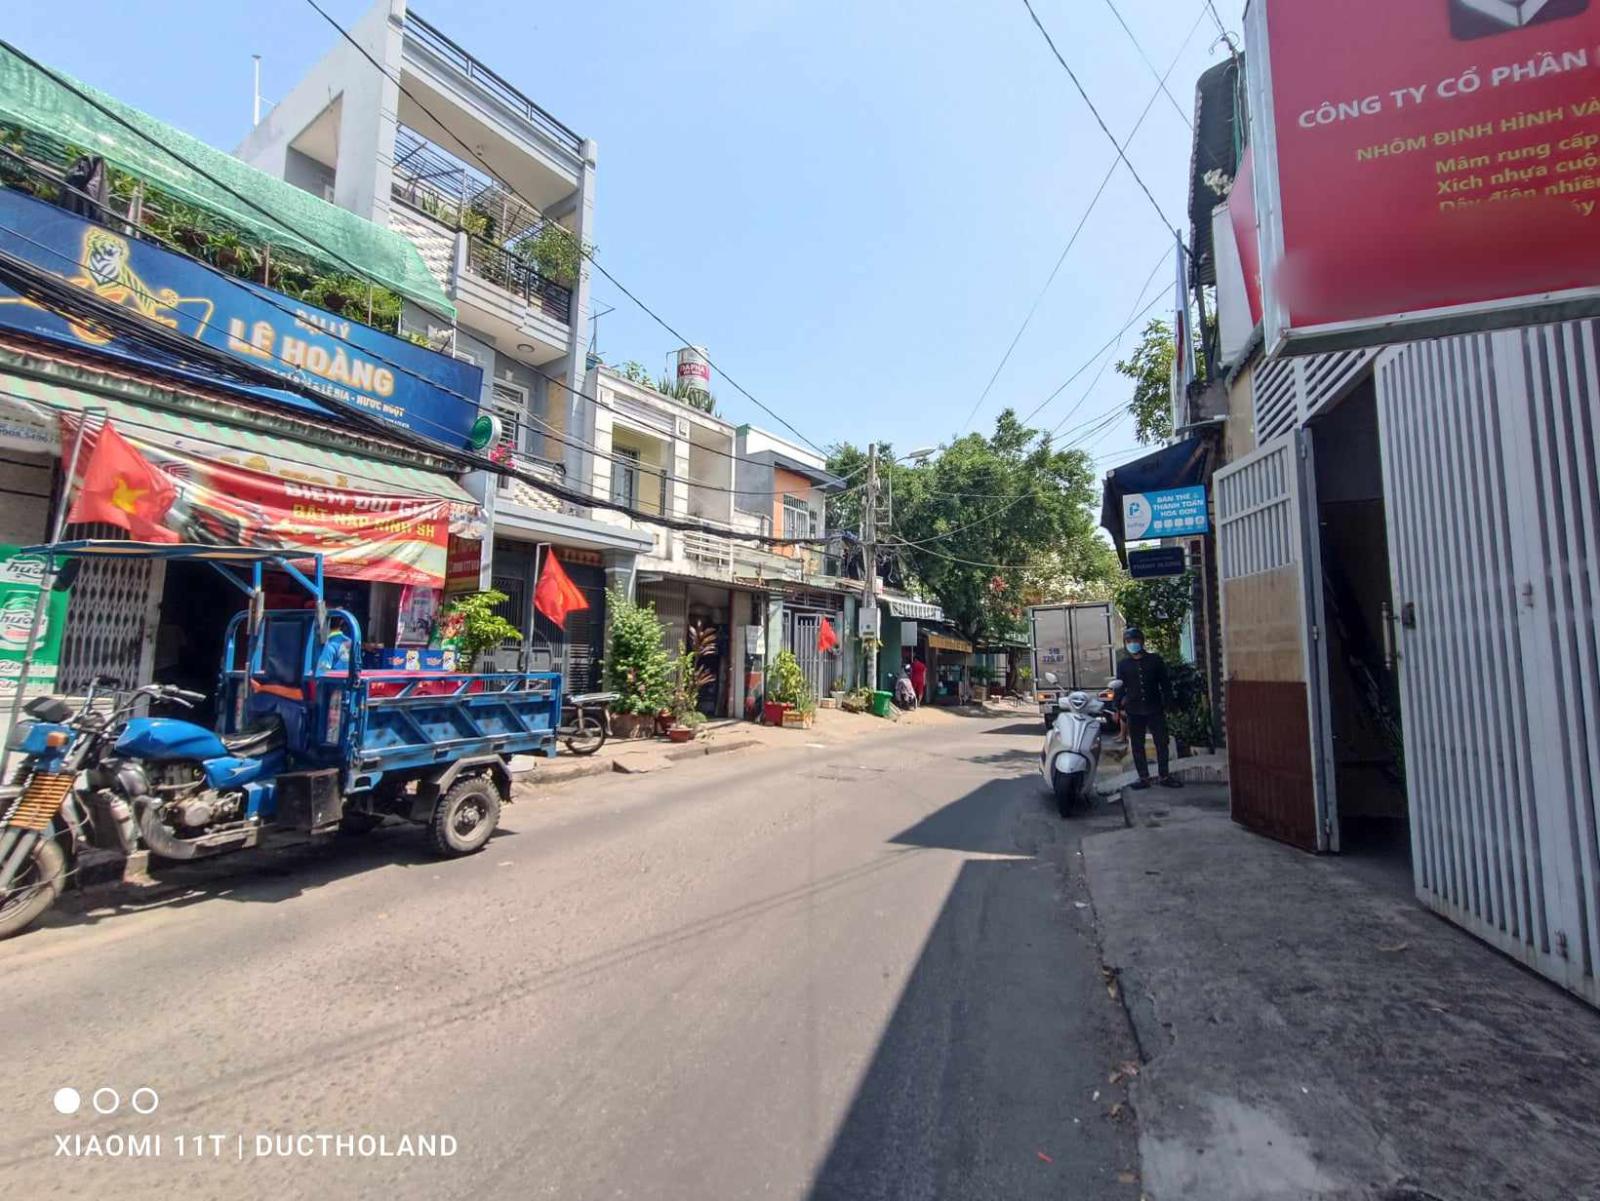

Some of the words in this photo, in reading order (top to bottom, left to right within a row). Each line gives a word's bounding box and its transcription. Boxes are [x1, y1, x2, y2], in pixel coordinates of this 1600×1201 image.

[1298, 95, 1382, 128] CÔNG
[1389, 84, 1427, 108] TY
[1436, 66, 1481, 98] CỔ
[1491, 48, 1588, 87] PHẦN
[1357, 135, 1427, 161] NHÔM
[1433, 122, 1493, 146] ĐỊNH
[1501, 106, 1564, 132] HÌNH
[1435, 154, 1490, 175] Mâm
[1497, 143, 1552, 164] rung
[1558, 131, 1599, 150] cấp
[1437, 174, 1483, 195] Xích
[1491, 164, 1548, 185] nhựa
[1555, 152, 1600, 173] cuộ
[228, 317, 276, 361] LÊ
[281, 334, 395, 397] HOÀNG
[416, 524, 436, 538] SH
